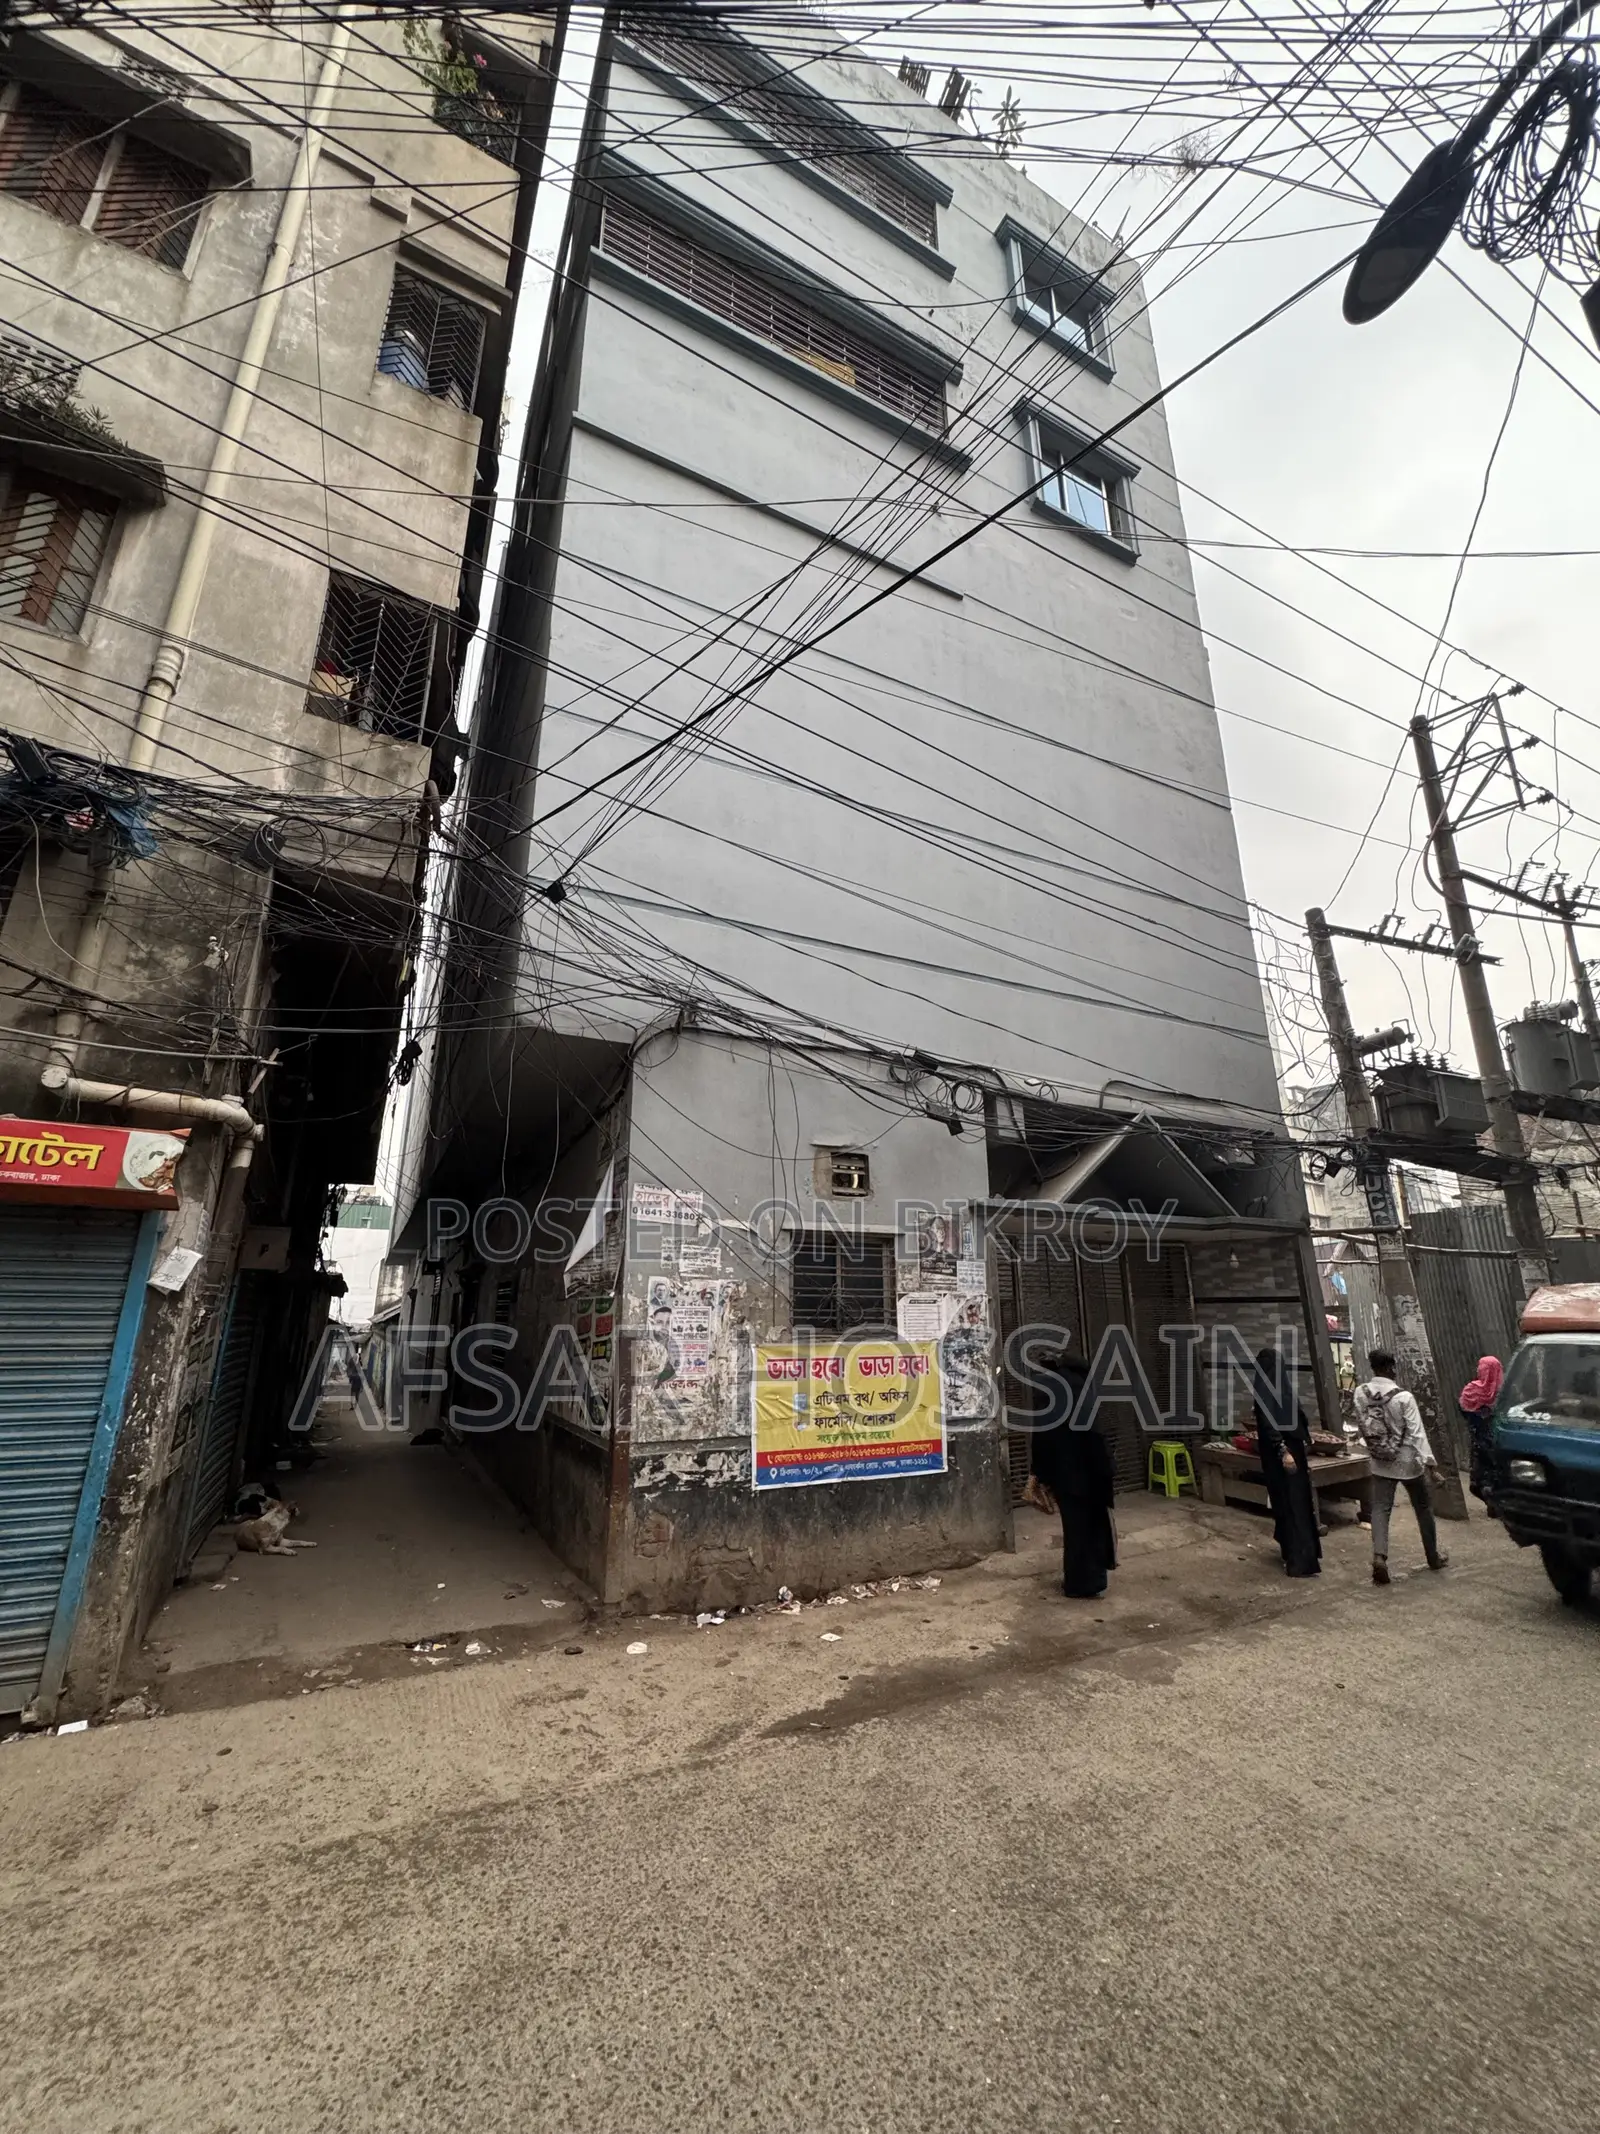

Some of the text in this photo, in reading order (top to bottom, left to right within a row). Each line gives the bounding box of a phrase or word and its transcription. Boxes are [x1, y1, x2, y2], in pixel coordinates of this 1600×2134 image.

[767, 1358, 807, 1381] ভাড়া
[811, 1357, 845, 1382] হবে!
[858, 1356, 894, 1378] ভাড়া
[898, 1355, 929, 1379] হবে!
[878, 1388, 909, 1403] অফিস
